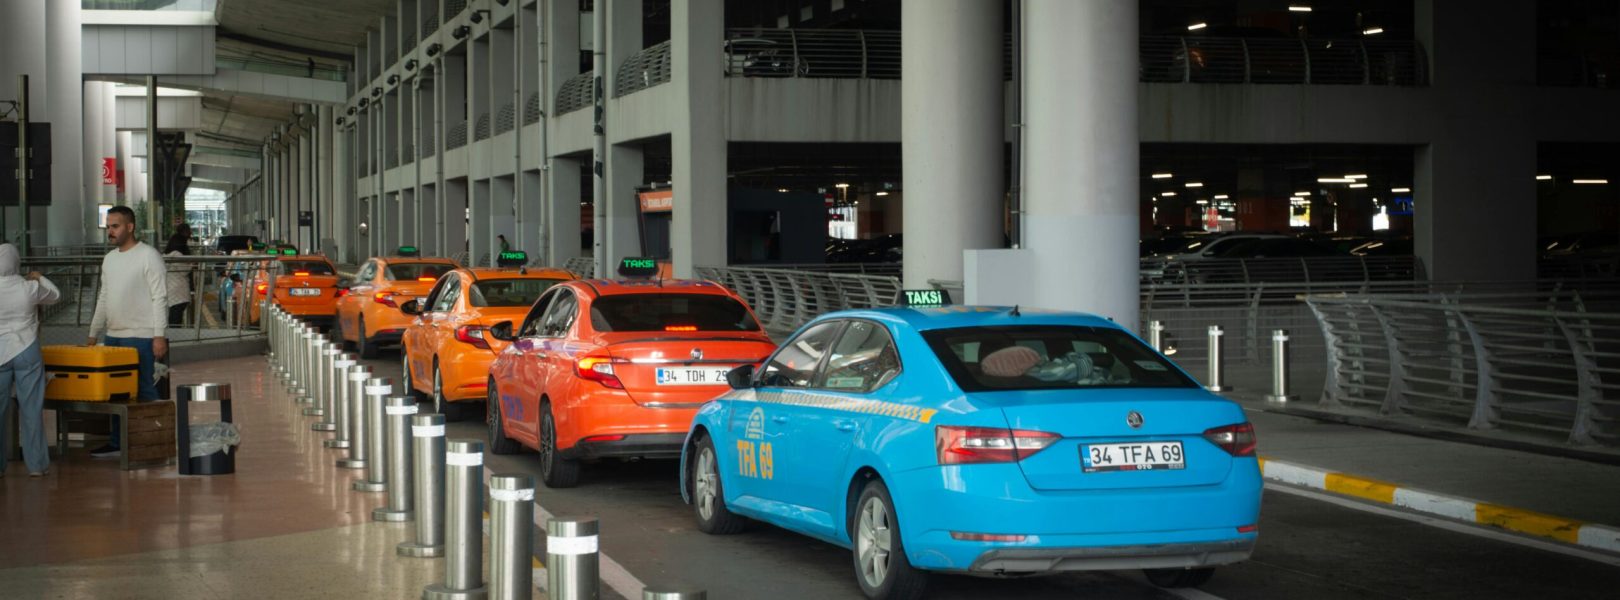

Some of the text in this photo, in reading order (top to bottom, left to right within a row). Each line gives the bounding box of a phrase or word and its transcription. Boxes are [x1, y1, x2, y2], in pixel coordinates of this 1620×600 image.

[664, 370, 677, 382] 34
[686, 370, 706, 382] TDH
[737, 440, 773, 480] TFA 69
[1091, 445, 1181, 464] 34 TFA 69
